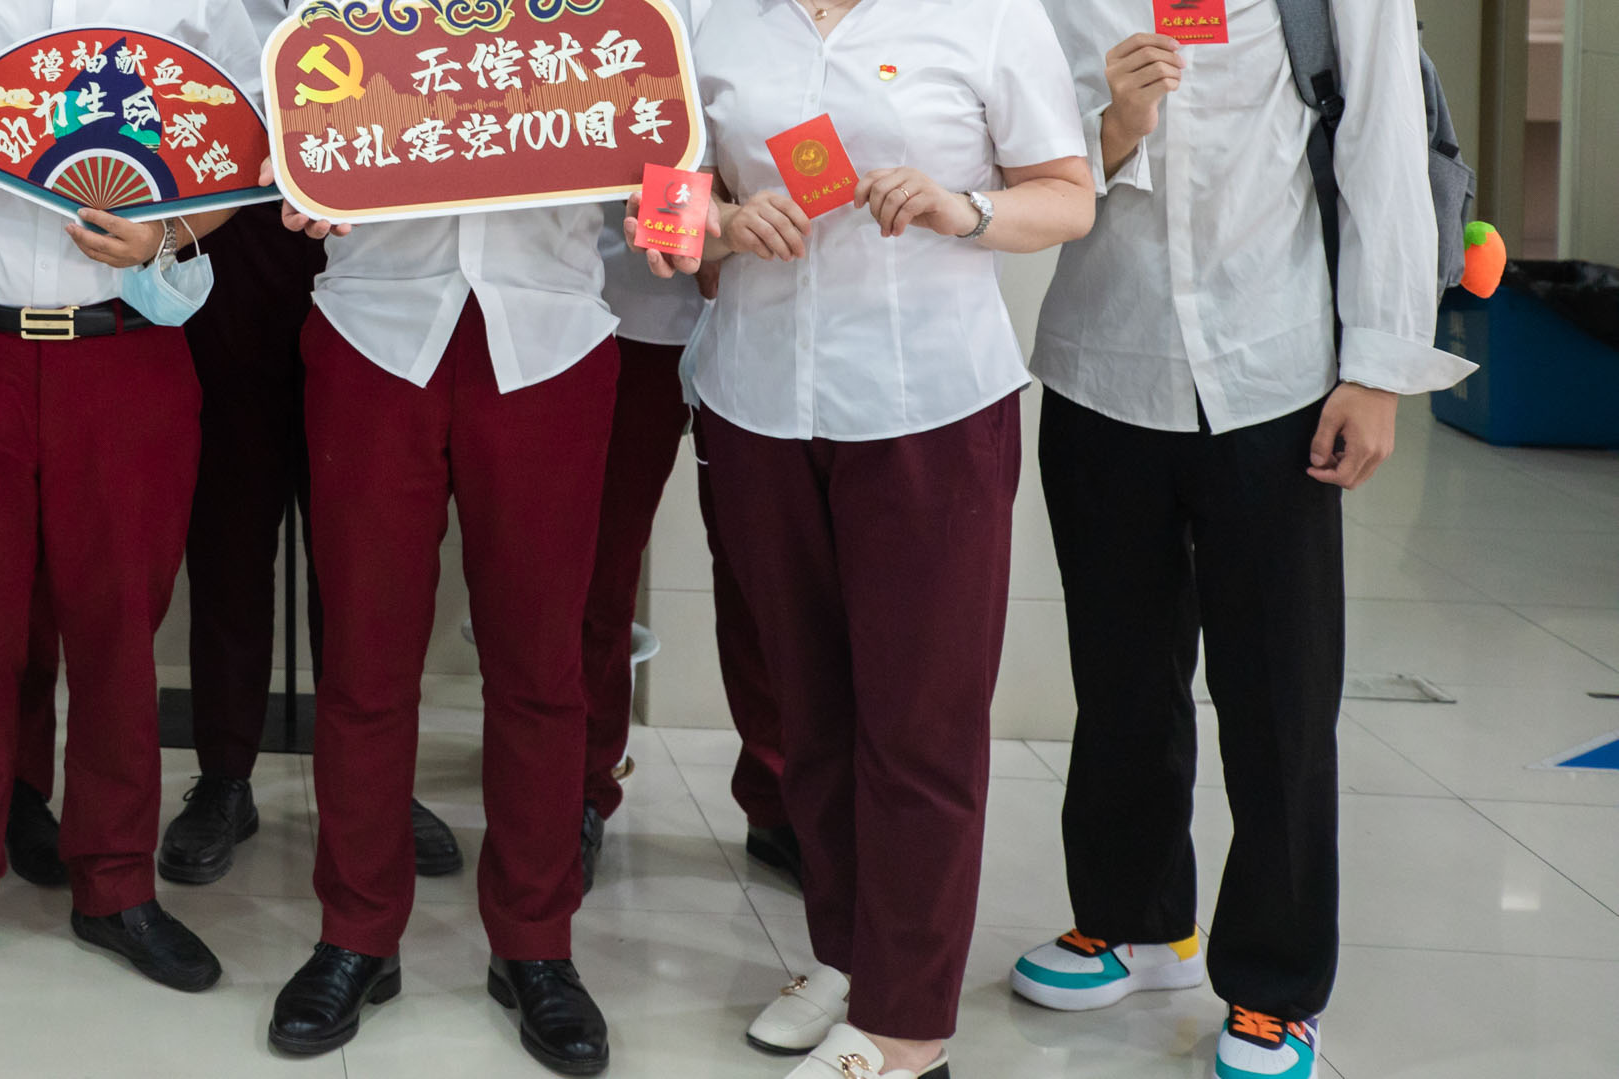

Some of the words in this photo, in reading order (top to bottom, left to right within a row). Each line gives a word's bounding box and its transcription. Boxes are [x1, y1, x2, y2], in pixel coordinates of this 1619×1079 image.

[29, 40, 184, 87] 撸袖献血
[410, 29, 647, 96] 无偿献血
[299, 96, 673, 174] 献礼建党100周年
